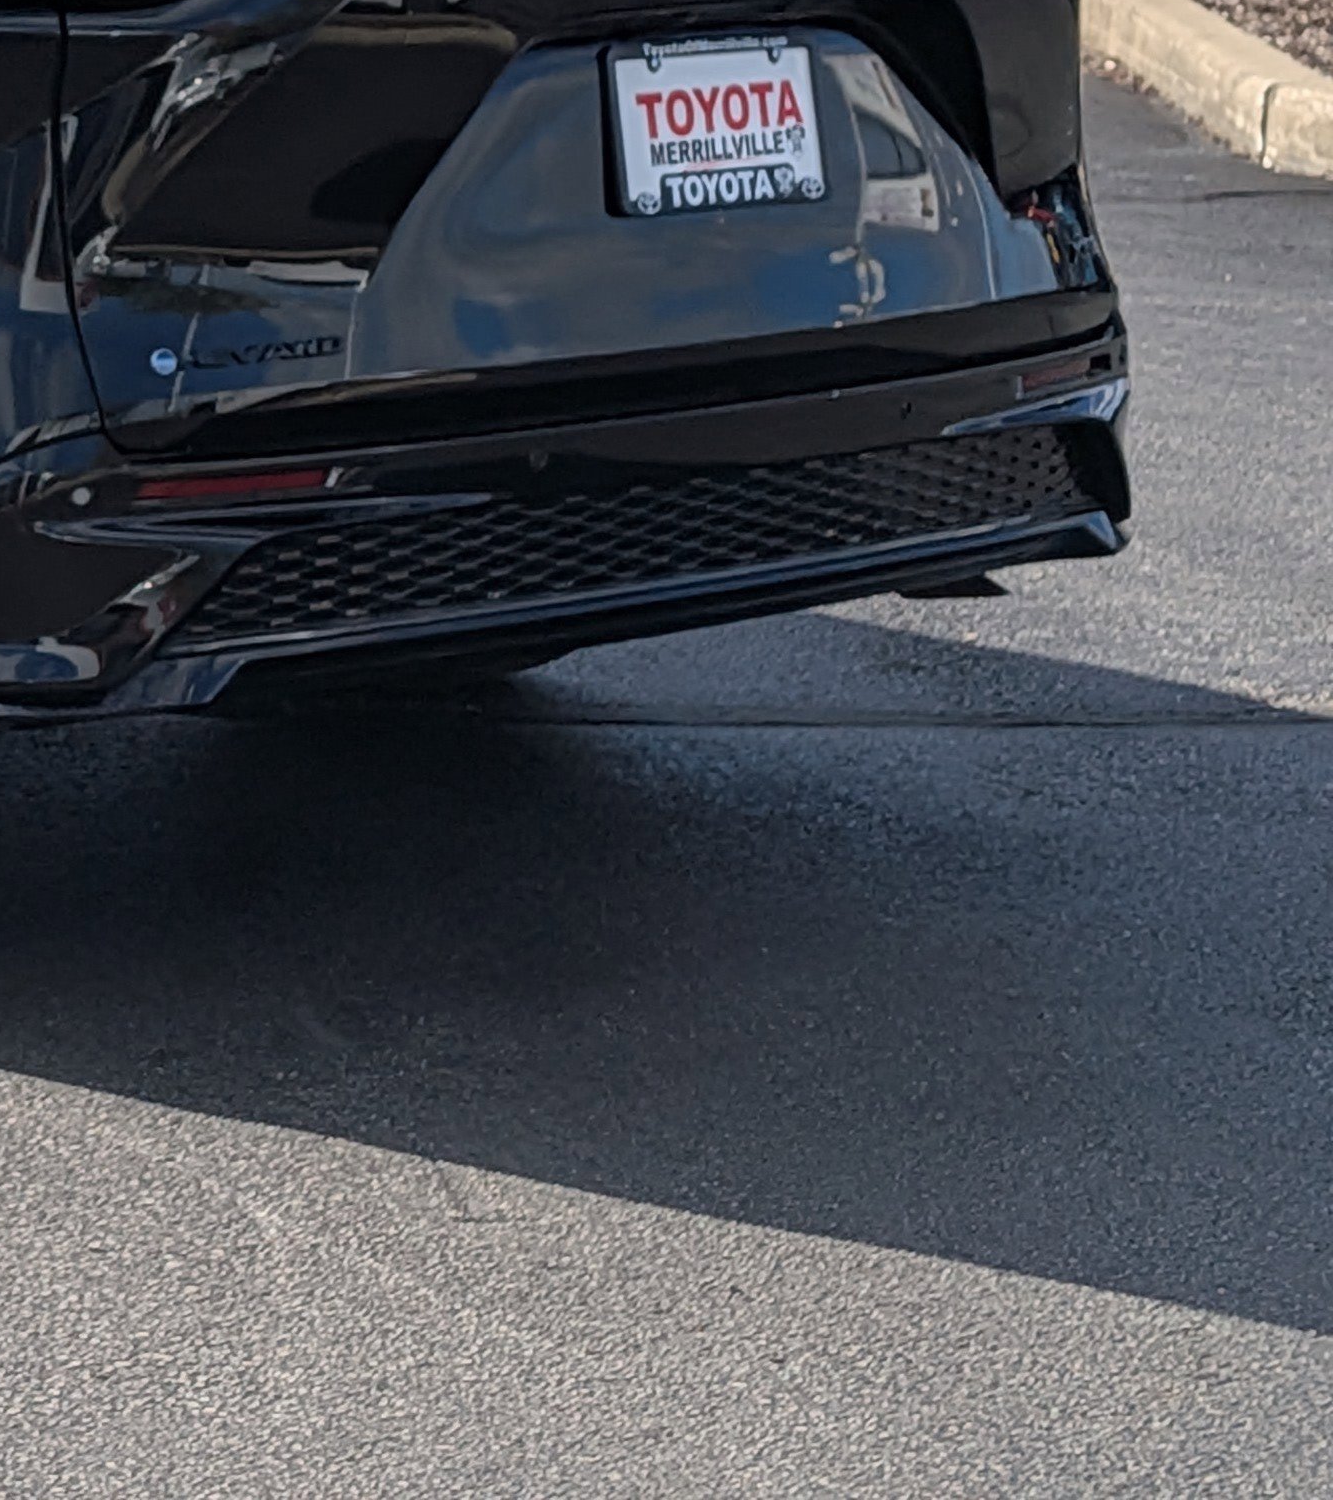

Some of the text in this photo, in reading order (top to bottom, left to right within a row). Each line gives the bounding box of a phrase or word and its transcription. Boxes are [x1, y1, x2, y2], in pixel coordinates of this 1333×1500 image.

[635, 80, 803, 139] TOYOTA
[649, 130, 786, 167] MERRILLVILLE
[665, 168, 776, 208] TOYOTA
